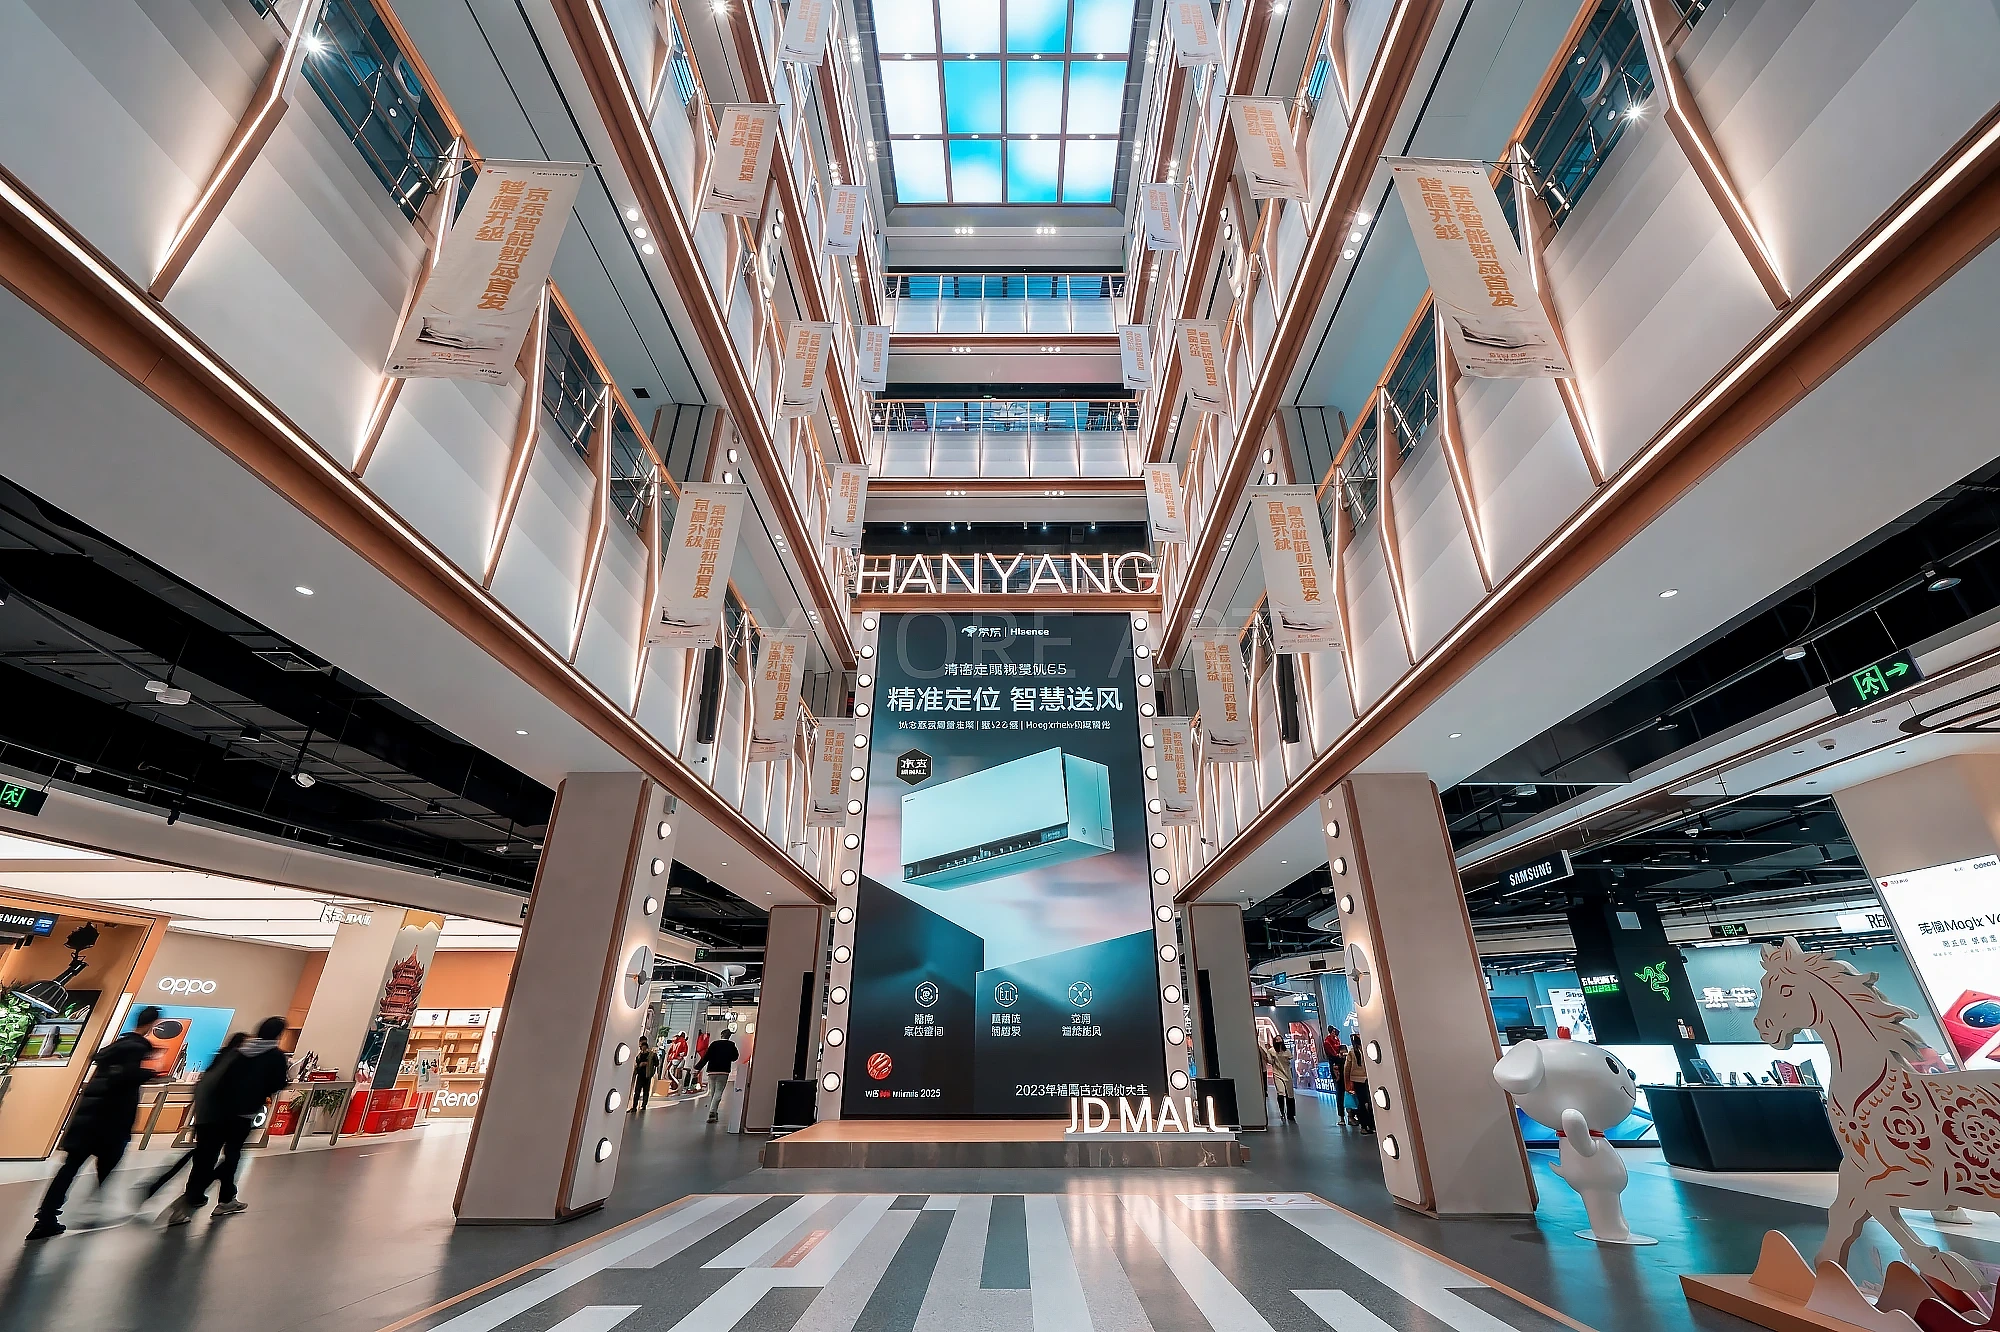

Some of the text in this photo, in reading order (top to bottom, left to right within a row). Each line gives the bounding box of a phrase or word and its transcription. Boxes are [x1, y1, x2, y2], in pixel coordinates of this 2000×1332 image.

[857, 552, 1160, 595] HANYANG
[887, 686, 1124, 713] 精准定位 智慧送风
[1509, 861, 1553, 887] SAMSUNG
[1065, 1096, 1231, 1134] JD MALL
